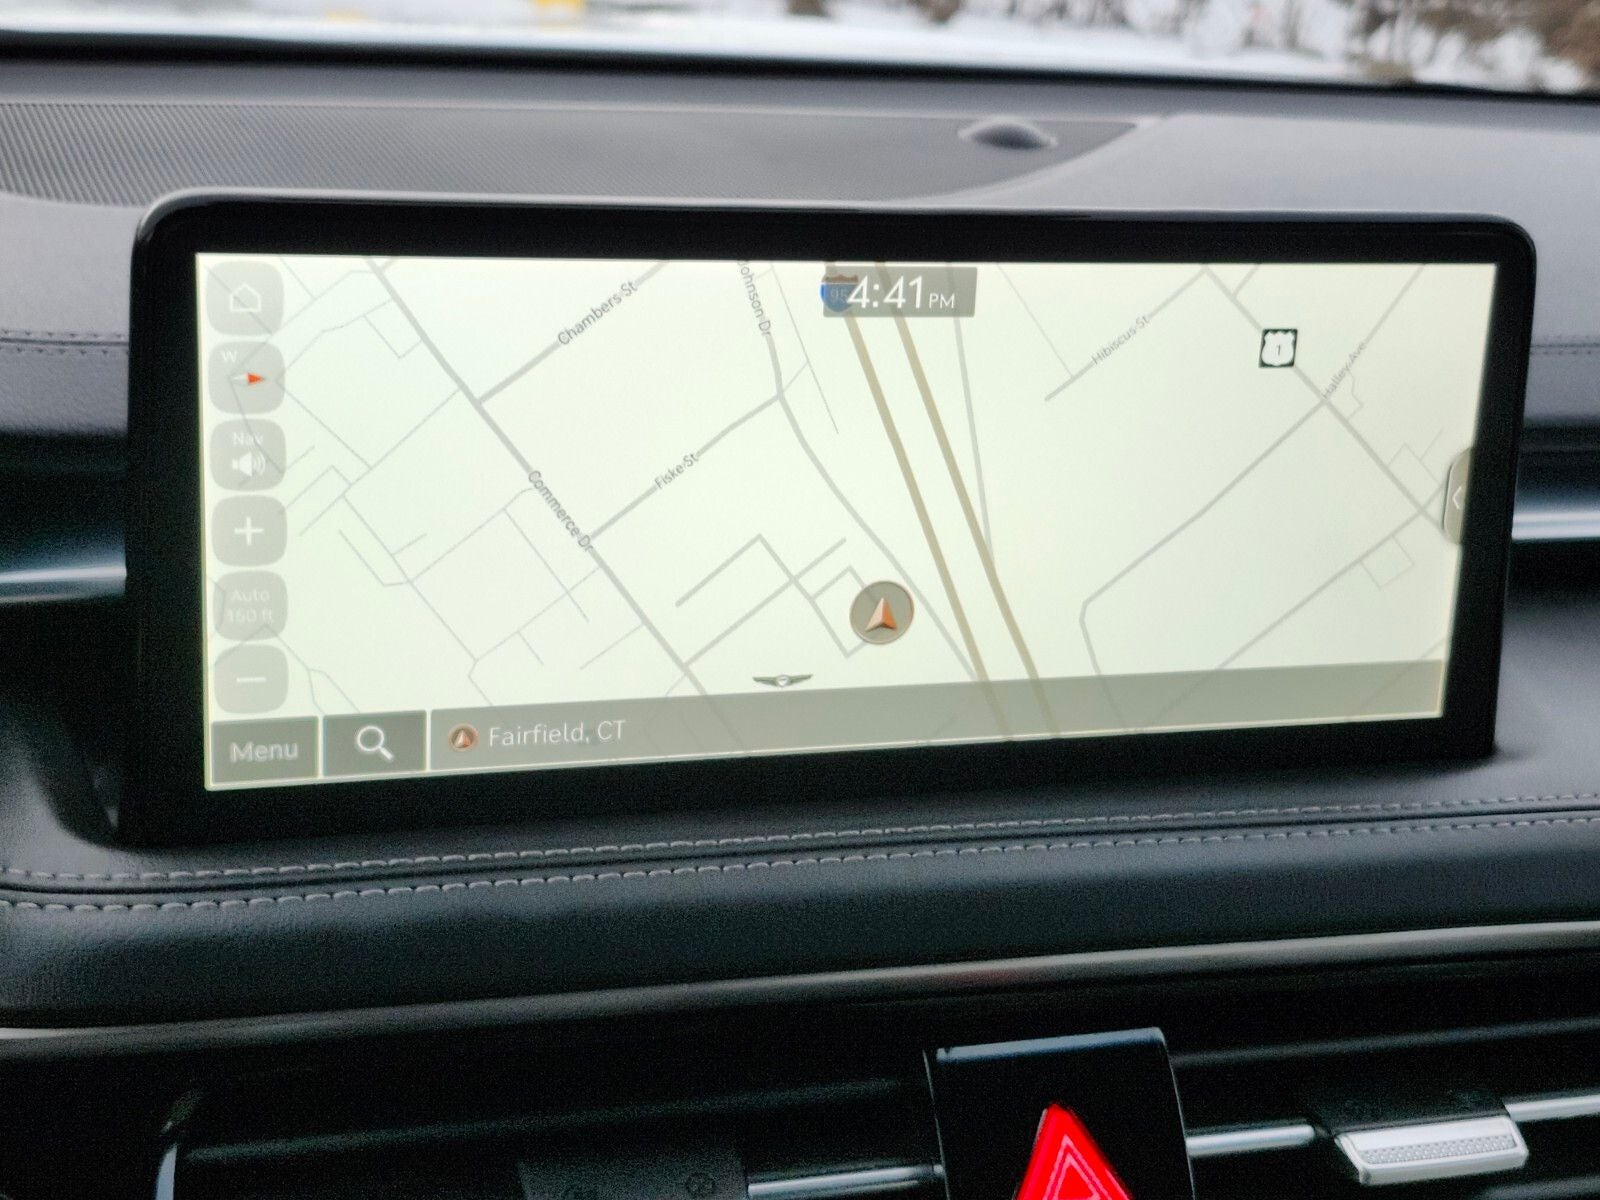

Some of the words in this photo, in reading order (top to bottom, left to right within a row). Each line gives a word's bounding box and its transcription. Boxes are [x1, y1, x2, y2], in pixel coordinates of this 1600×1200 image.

[847, 275, 922, 309] 4:41
[928, 292, 956, 309] PM
[558, 293, 622, 345] Chambers
[620, 281, 638, 297] St
[758, 320, 771, 337] Dr
[1091, 325, 1137, 365] Hibiscus
[1135, 312, 1151, 330] St
[220, 350, 239, 364] W
[1348, 342, 1367, 369] Ave
[232, 431, 263, 447] Nav
[654, 464, 685, 489] Fiske
[682, 453, 699, 468] St
[528, 470, 580, 537] Commerce
[578, 534, 594, 552] Dr
[230, 588, 271, 602] Auto
[489, 721, 591, 748] Fairfield,
[597, 719, 627, 742] CT
[230, 741, 298, 763] Menu
